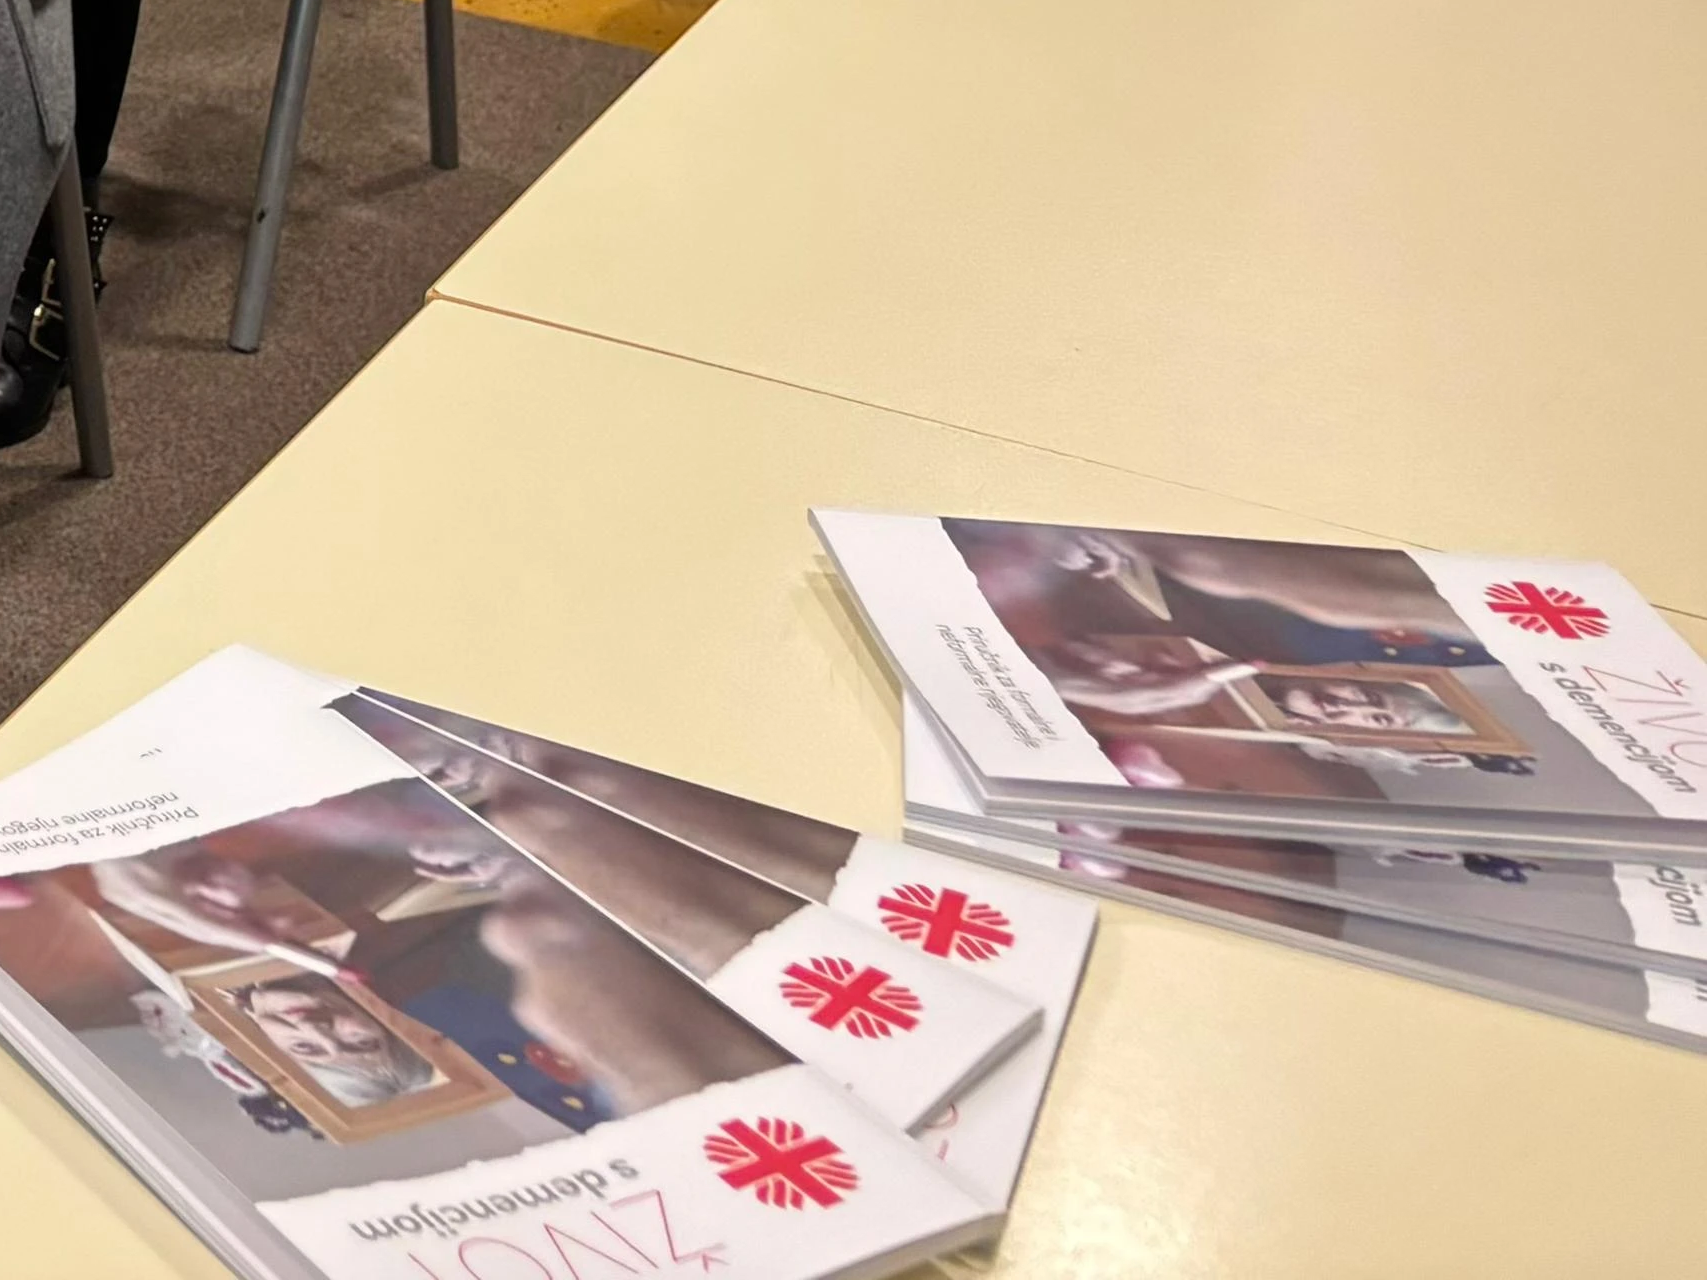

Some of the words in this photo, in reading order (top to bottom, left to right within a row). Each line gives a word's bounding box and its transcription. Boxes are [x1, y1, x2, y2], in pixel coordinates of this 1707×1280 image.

[1554, 675, 1699, 794] demencijom
[63, 791, 180, 826] neformalne
[110, 805, 200, 837] Priručnik
[81, 828, 106, 840] za
[608, 1157, 640, 1181] s
[348, 1168, 612, 1240] demencijom
[408, 1188, 730, 1280] ŽIVO
